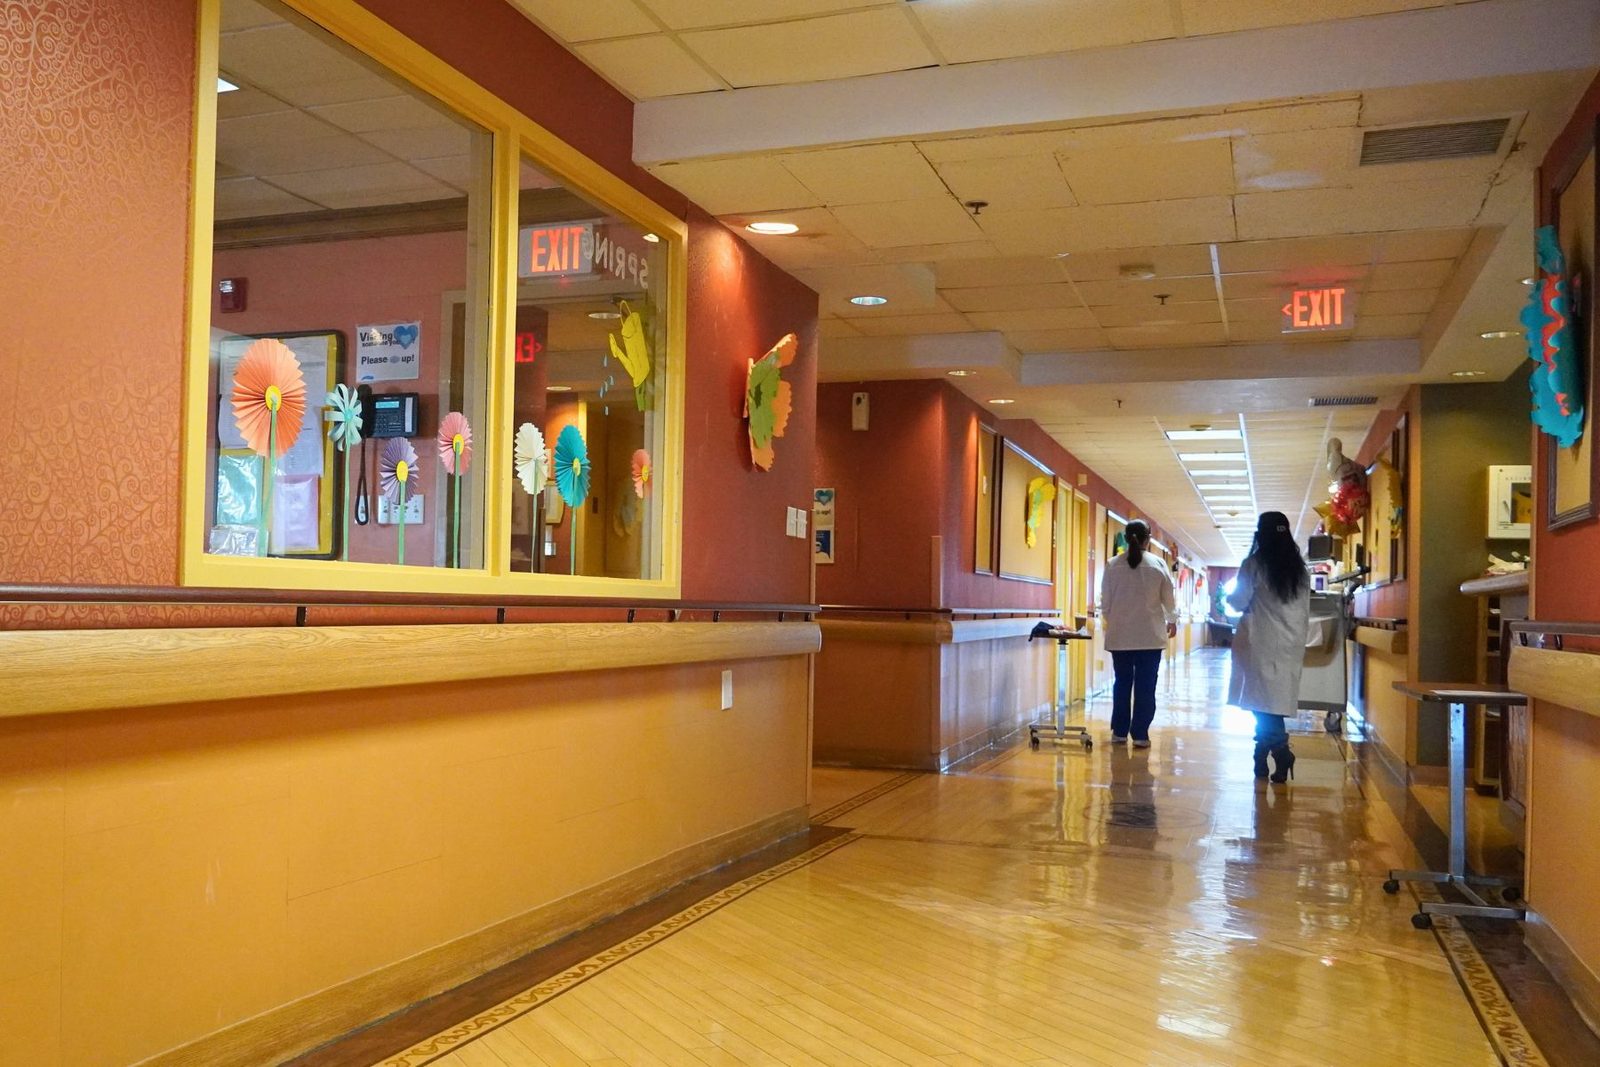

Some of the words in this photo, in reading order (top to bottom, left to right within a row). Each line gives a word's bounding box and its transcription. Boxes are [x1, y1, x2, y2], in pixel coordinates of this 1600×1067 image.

[532, 226, 584, 272] EXIT
[1293, 288, 1345, 327] EXIT
[361, 356, 388, 365] Please
[401, 354, 414, 364] up!
